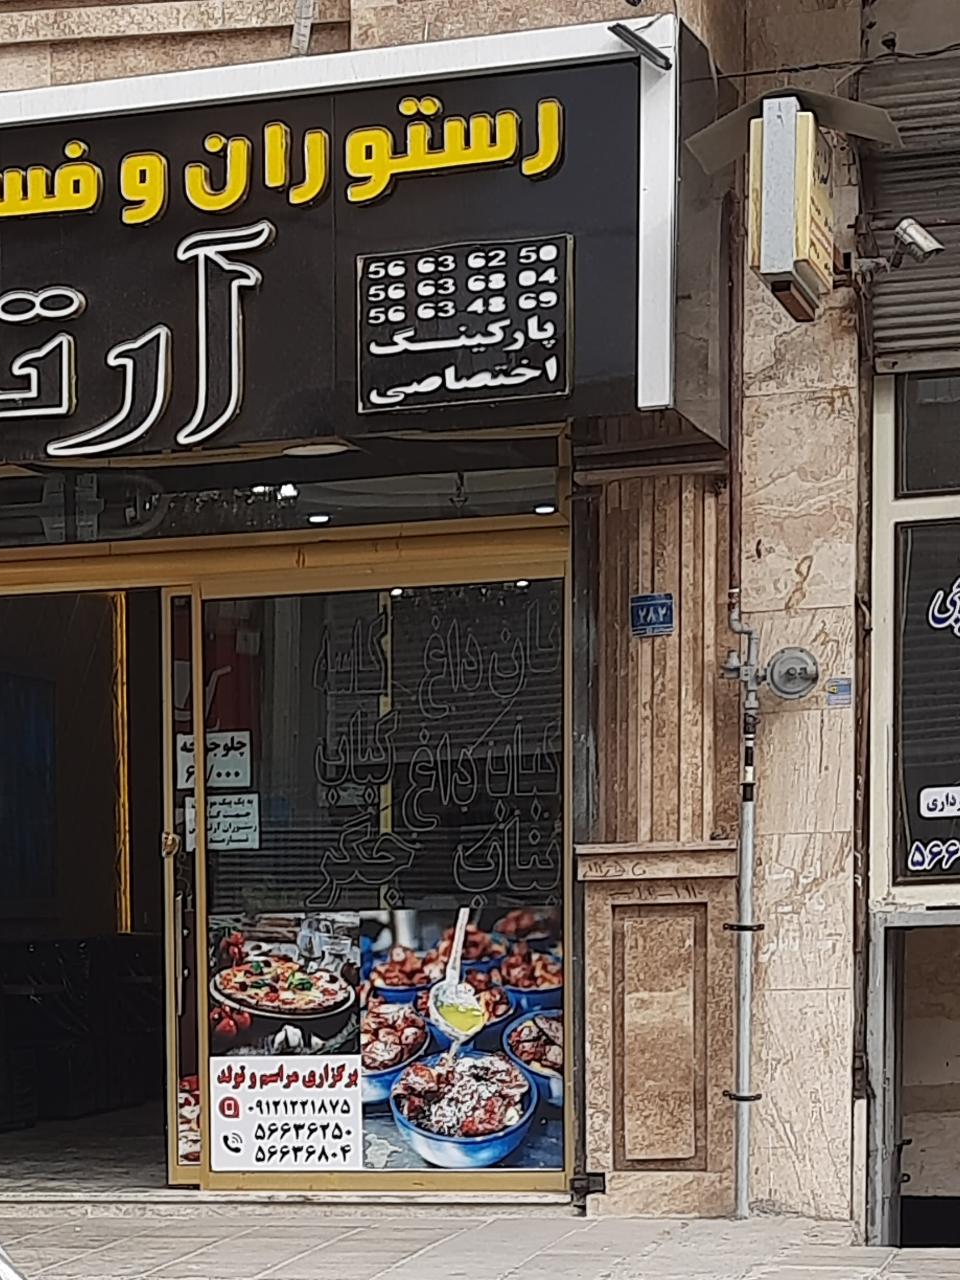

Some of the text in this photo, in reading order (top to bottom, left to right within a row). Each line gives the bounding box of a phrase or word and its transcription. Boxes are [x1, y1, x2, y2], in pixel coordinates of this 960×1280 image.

[184, 96, 565, 213] رستوران
[120, 151, 168, 225] و
[367, 244, 558, 279] 56 63 62 50
[367, 282, 407, 301] 56
[416, 277, 456, 296] 63
[517, 266, 558, 287] 04
[367, 305, 407, 324] 56
[416, 300, 456, 319] 63
[517, 290, 558, 309] 69
[368, 315, 556, 355] پارکینگ
[368, 355, 558, 405] اختصاصی
[216, 1062, 360, 1090] برگزاری مراسم و تولد
[254, 1121, 353, 1141] ۵۶۶۳۶۲۵۰
[254, 1143, 352, 1163] ۵۶۶۳۶۸۰۴
